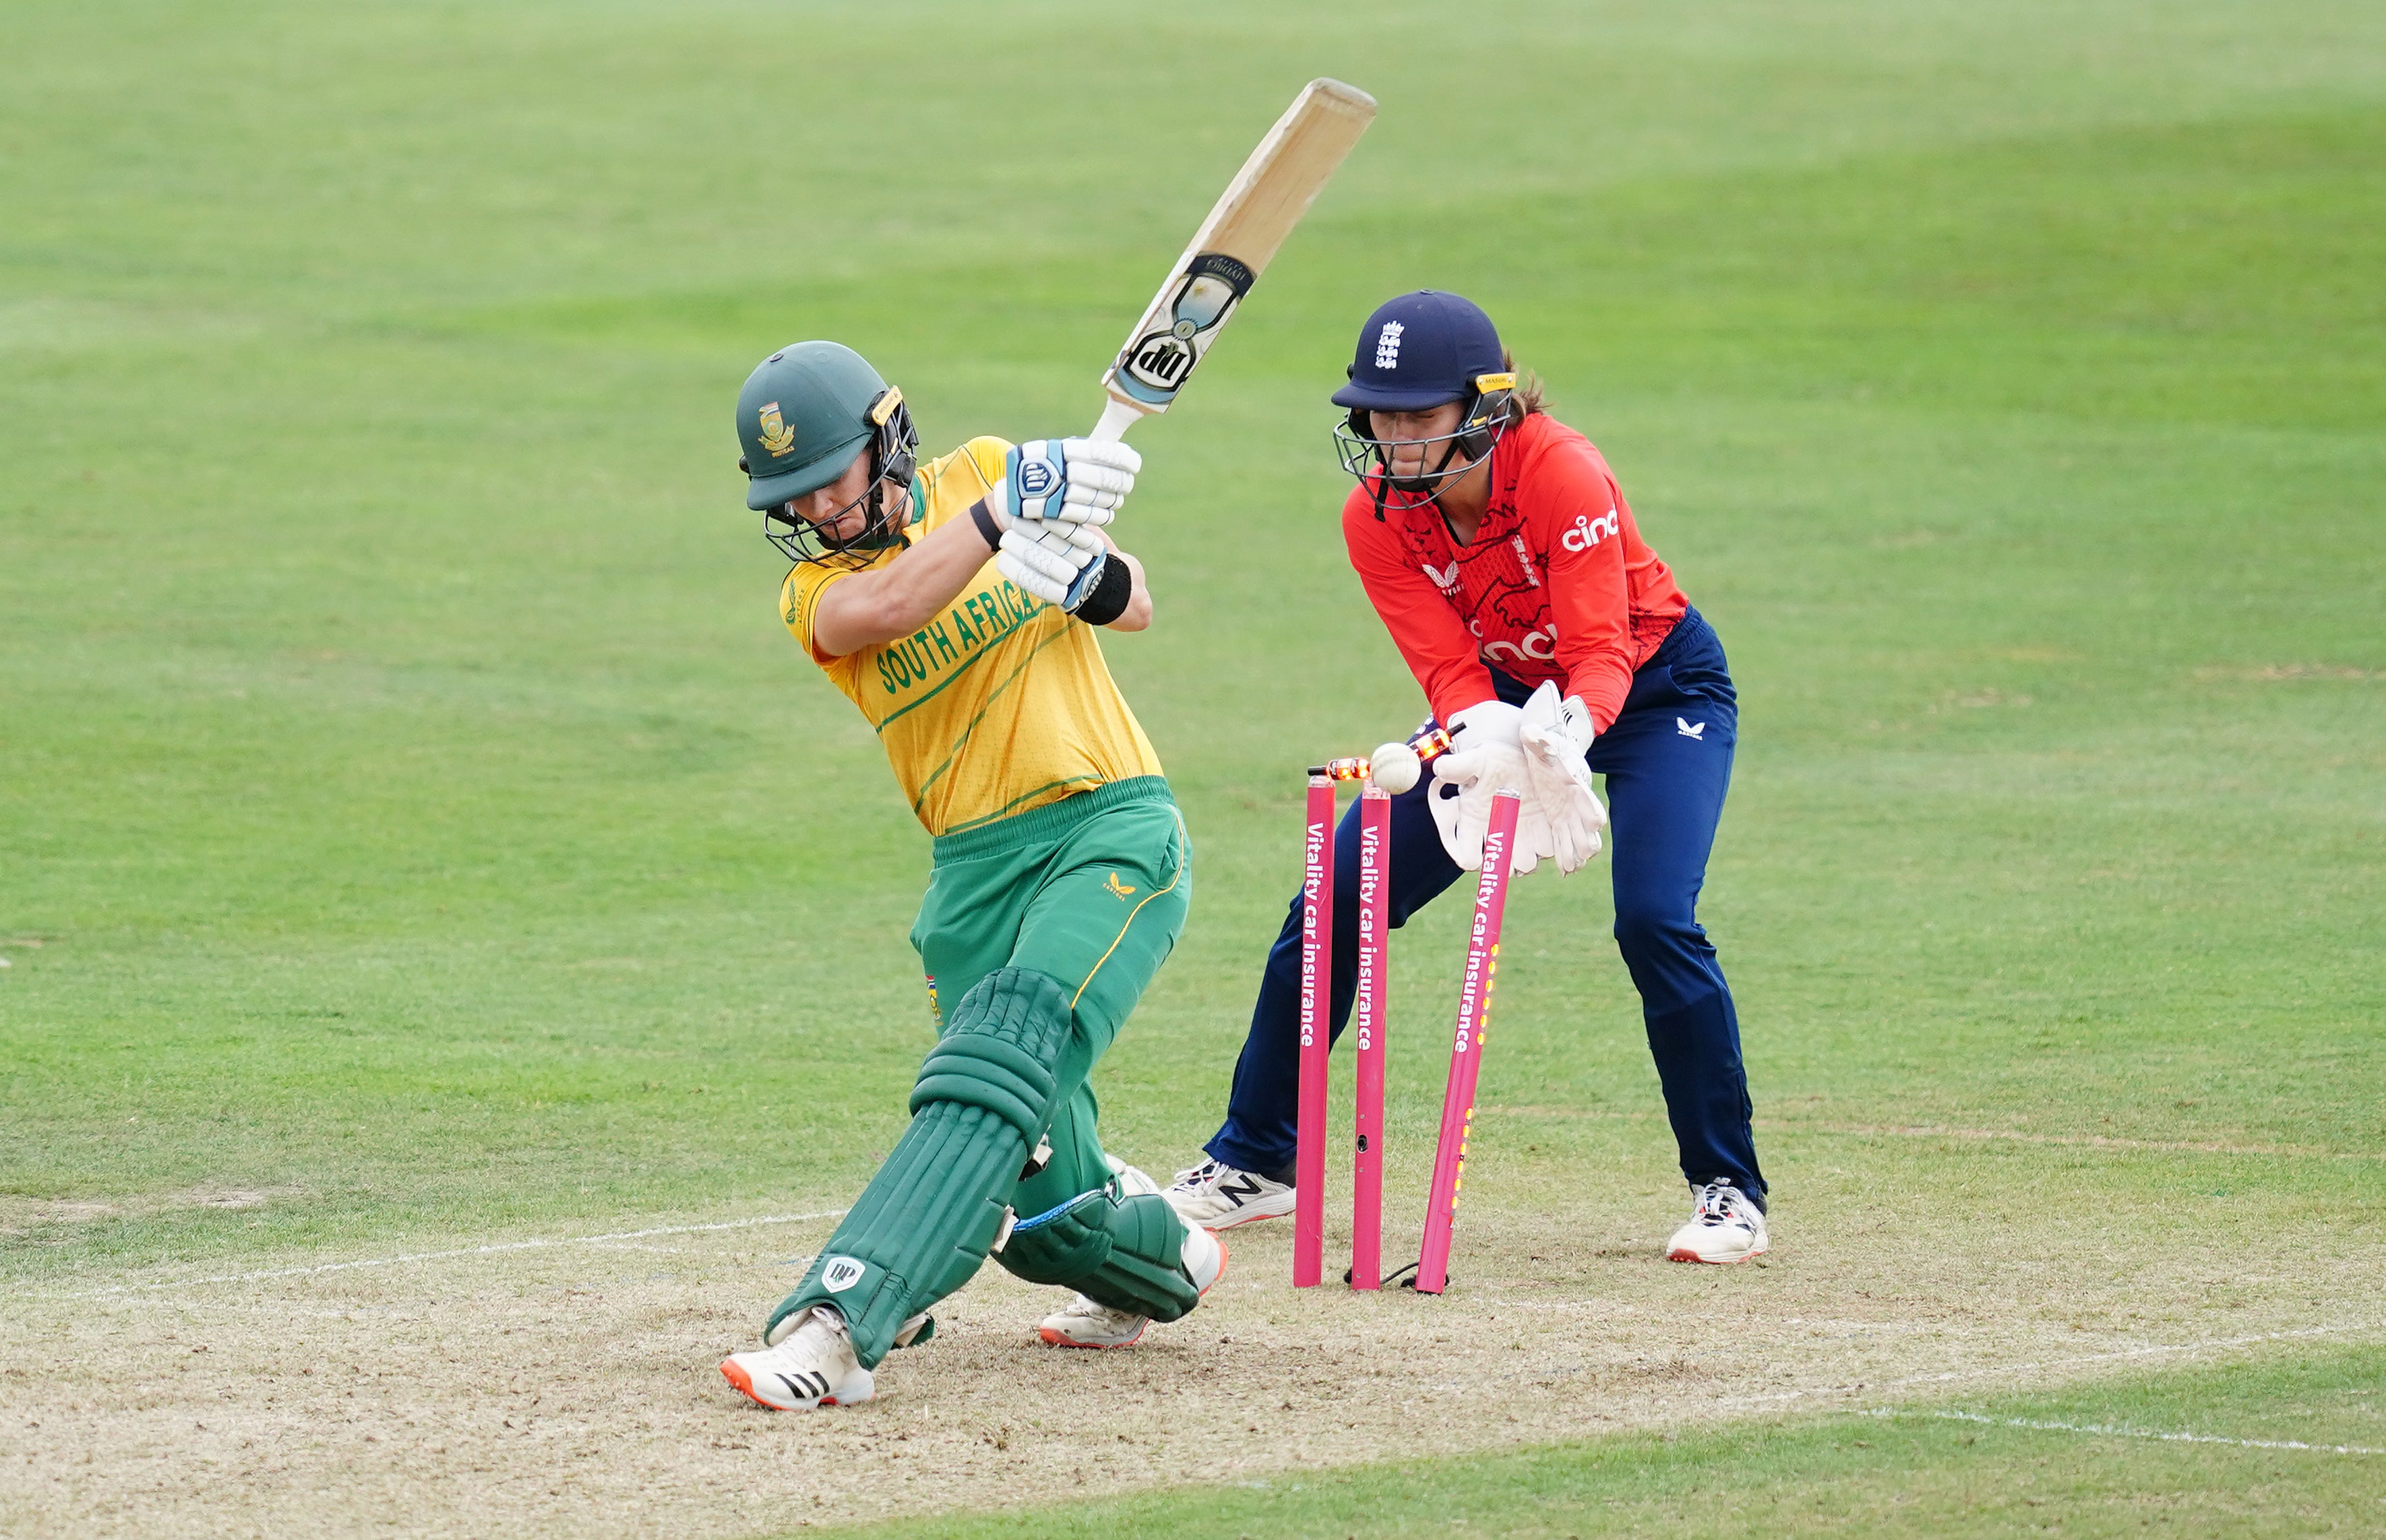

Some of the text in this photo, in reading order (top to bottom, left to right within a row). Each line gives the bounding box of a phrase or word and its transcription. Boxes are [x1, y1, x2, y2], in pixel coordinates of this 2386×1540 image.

[876, 580, 1034, 695] SOUTH AFRICA
[1562, 503, 1618, 552] cinc
[1301, 822, 1324, 1047] Vitality car insurance
[1358, 826, 1380, 1051] Vitality car insurance
[1455, 832, 1504, 1053] Vitality car insurance
